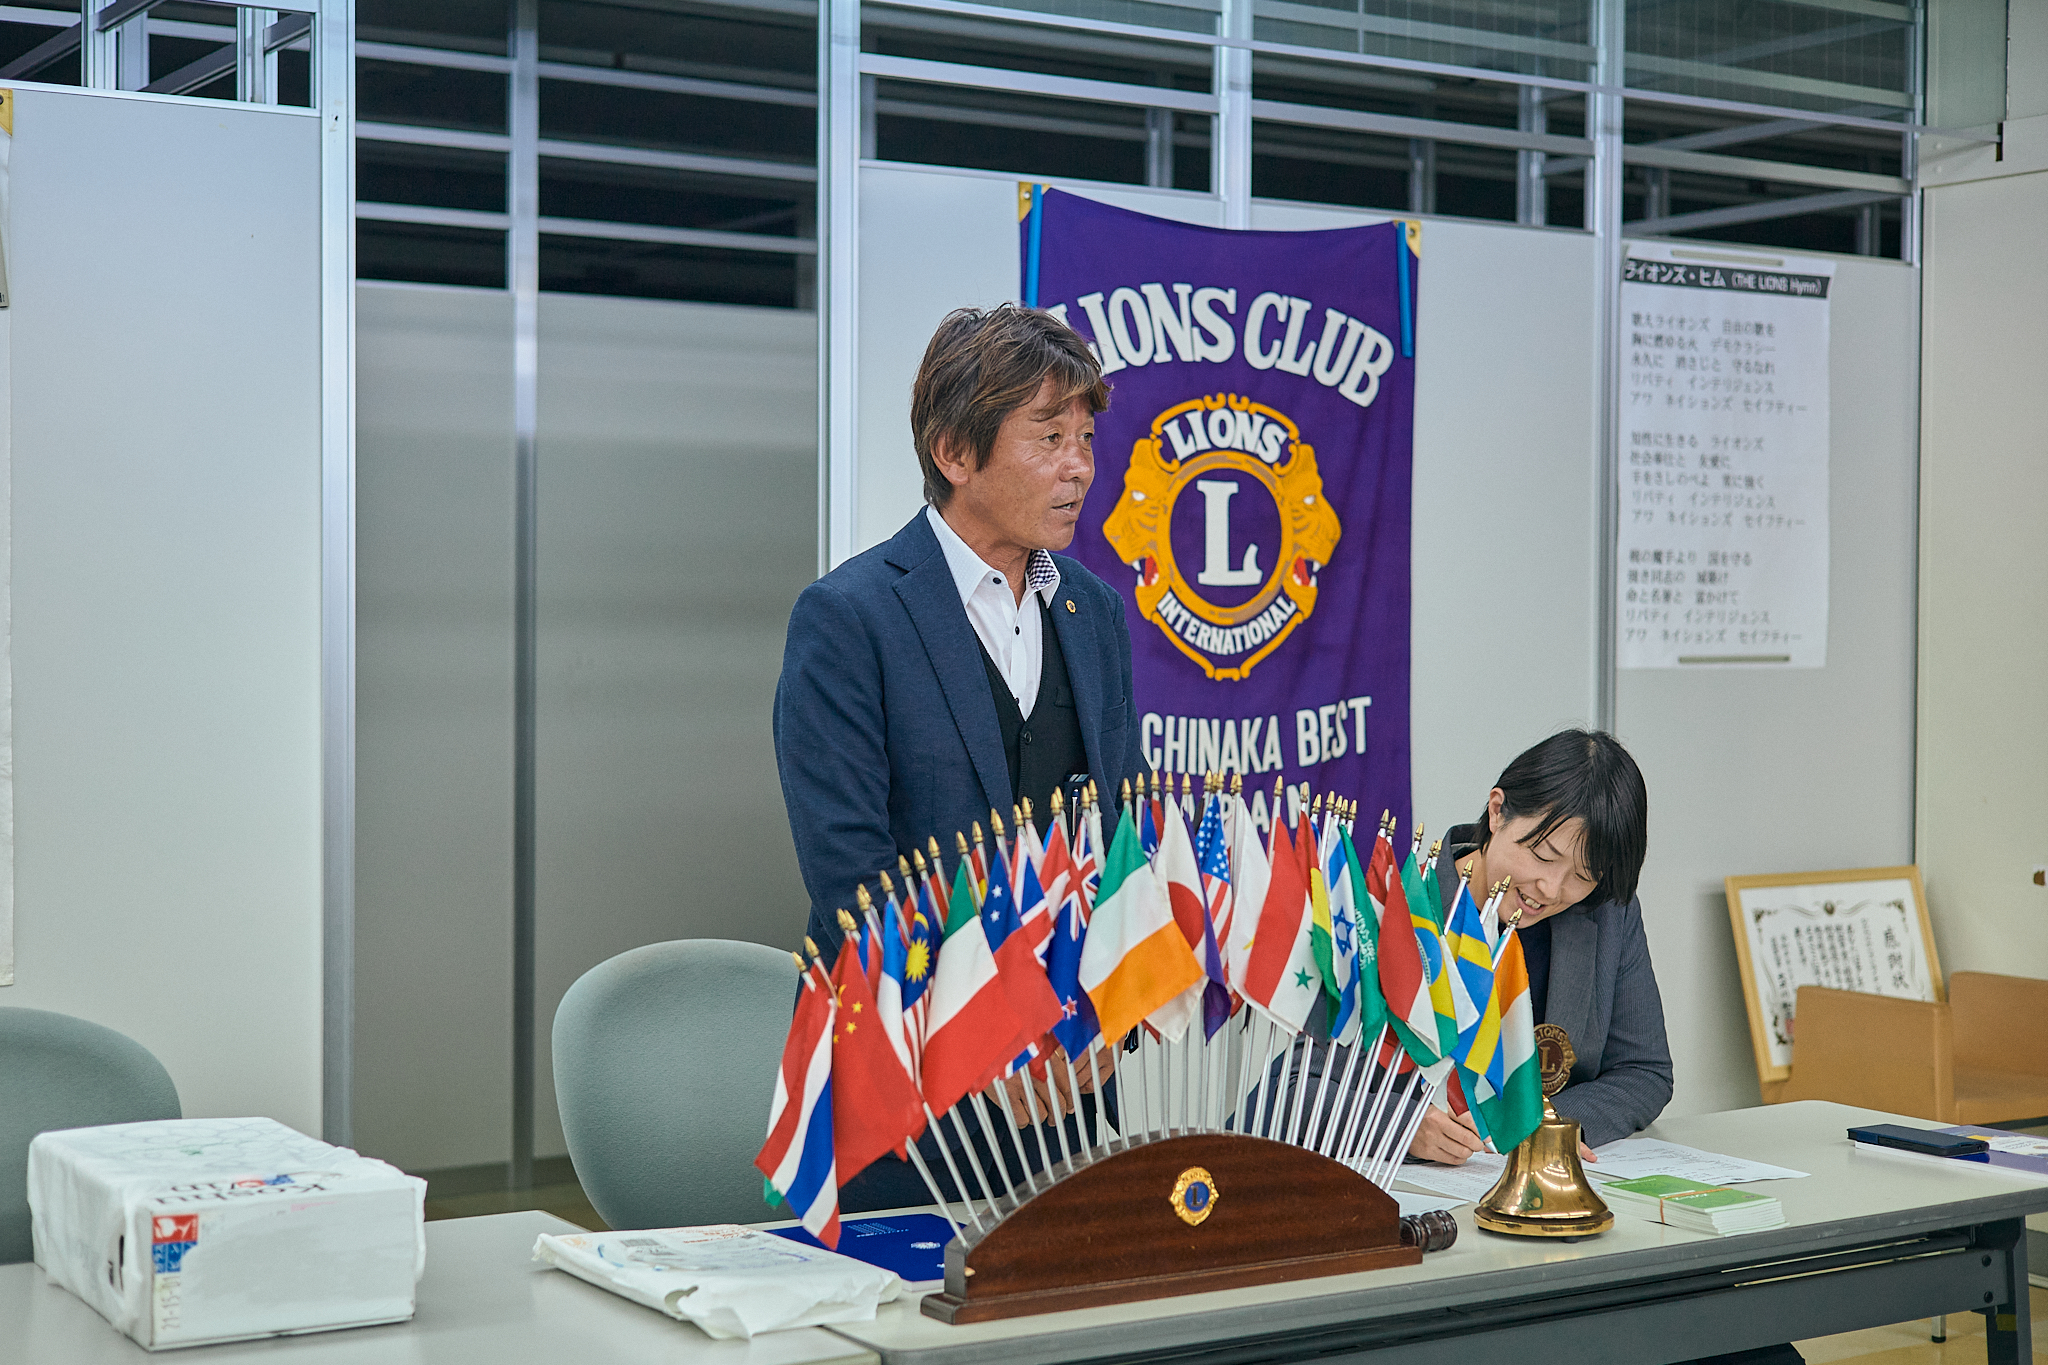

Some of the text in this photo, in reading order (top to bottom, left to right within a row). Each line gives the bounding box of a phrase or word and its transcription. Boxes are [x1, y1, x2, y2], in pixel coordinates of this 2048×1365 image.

[1625, 261, 1726, 287] ライオンズ・ヒム
[1243, 291, 1395, 408] CLUB
[1163, 408, 1288, 464] LIONS
[1197, 480, 1263, 586] L
[1156, 591, 1297, 655] INTERNATIONAL
[1296, 695, 1373, 768] BEST
[1540, 1046, 1556, 1073] L
[1190, 1185, 1203, 1207] L
